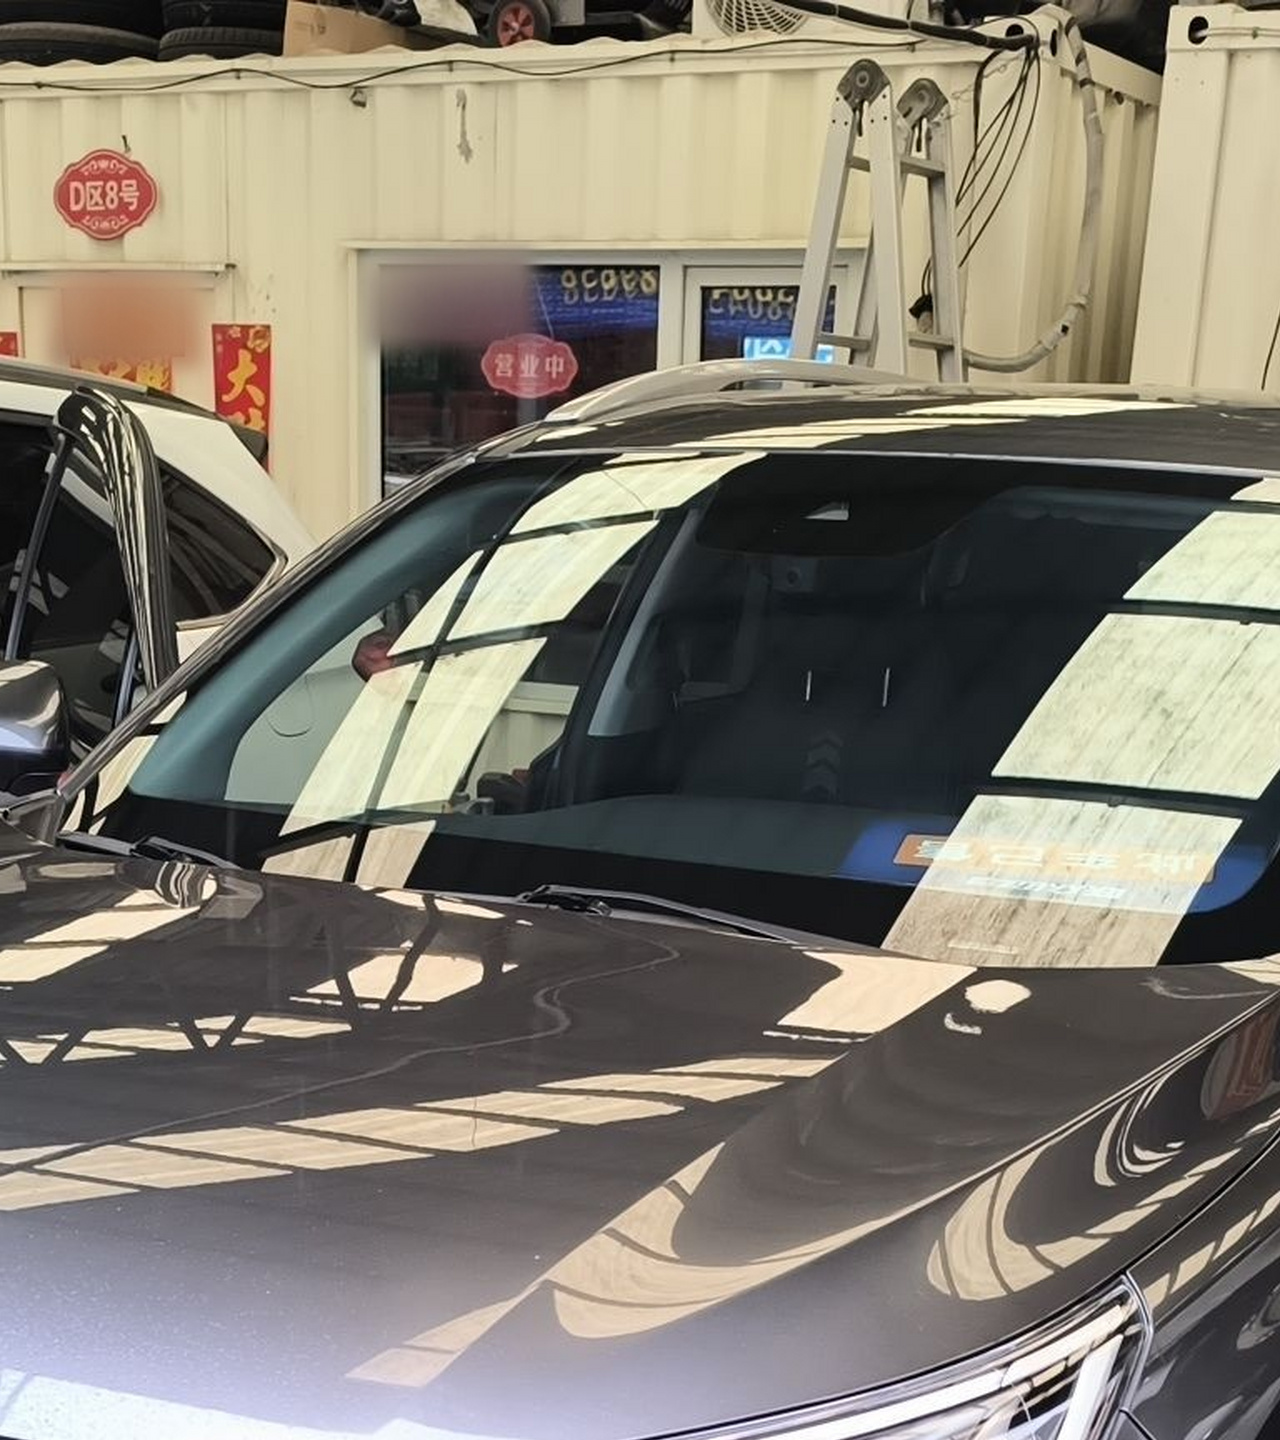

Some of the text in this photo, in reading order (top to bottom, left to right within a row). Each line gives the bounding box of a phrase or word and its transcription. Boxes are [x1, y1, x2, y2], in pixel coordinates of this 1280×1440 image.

[69, 180, 140, 211] D区8号
[494, 353, 564, 379] 营业中
